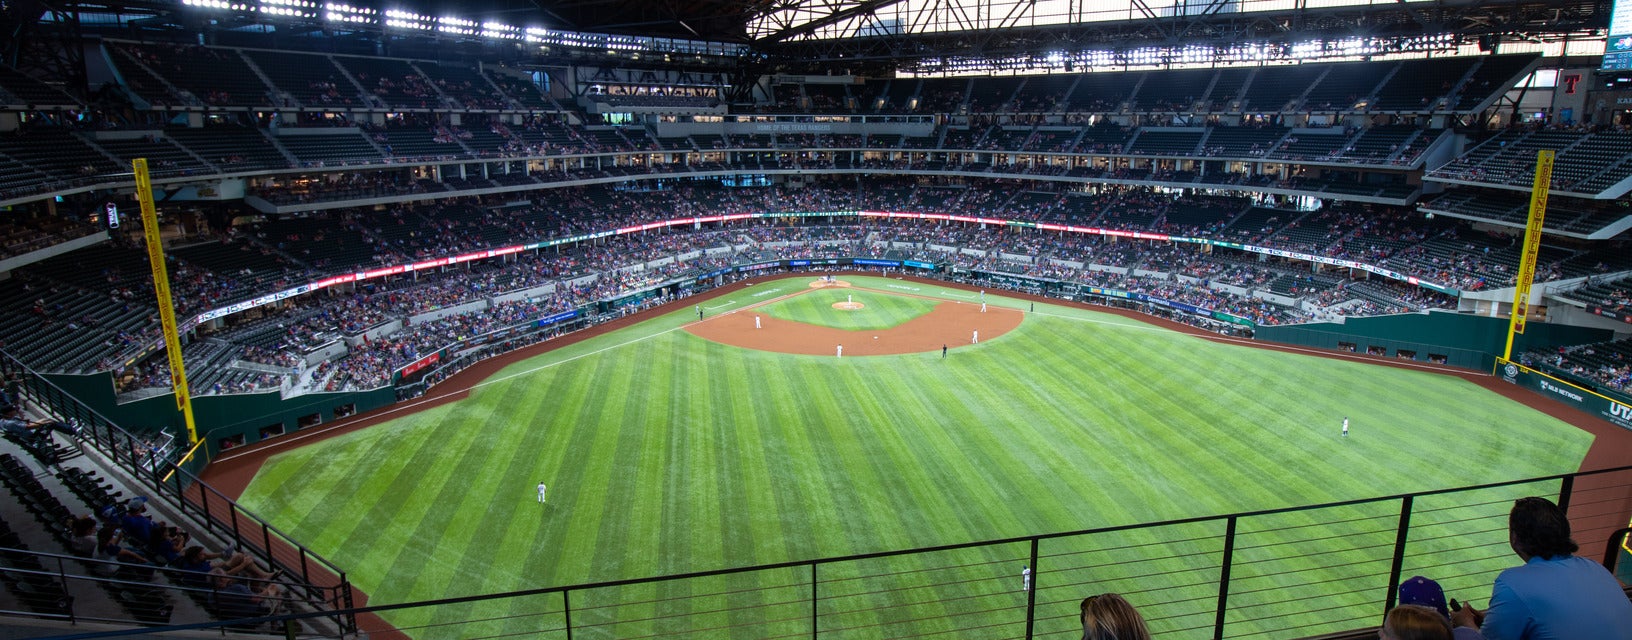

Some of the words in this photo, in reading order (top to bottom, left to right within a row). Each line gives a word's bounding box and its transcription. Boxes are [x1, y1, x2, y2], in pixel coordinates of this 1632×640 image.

[1564, 74, 1582, 94] T
[1534, 165, 1549, 219] BRING
[1529, 221, 1541, 251] THE
[1523, 254, 1535, 292] HEAT
[1548, 384, 1558, 393] MLB
[1559, 388, 1583, 402] NETWORK
